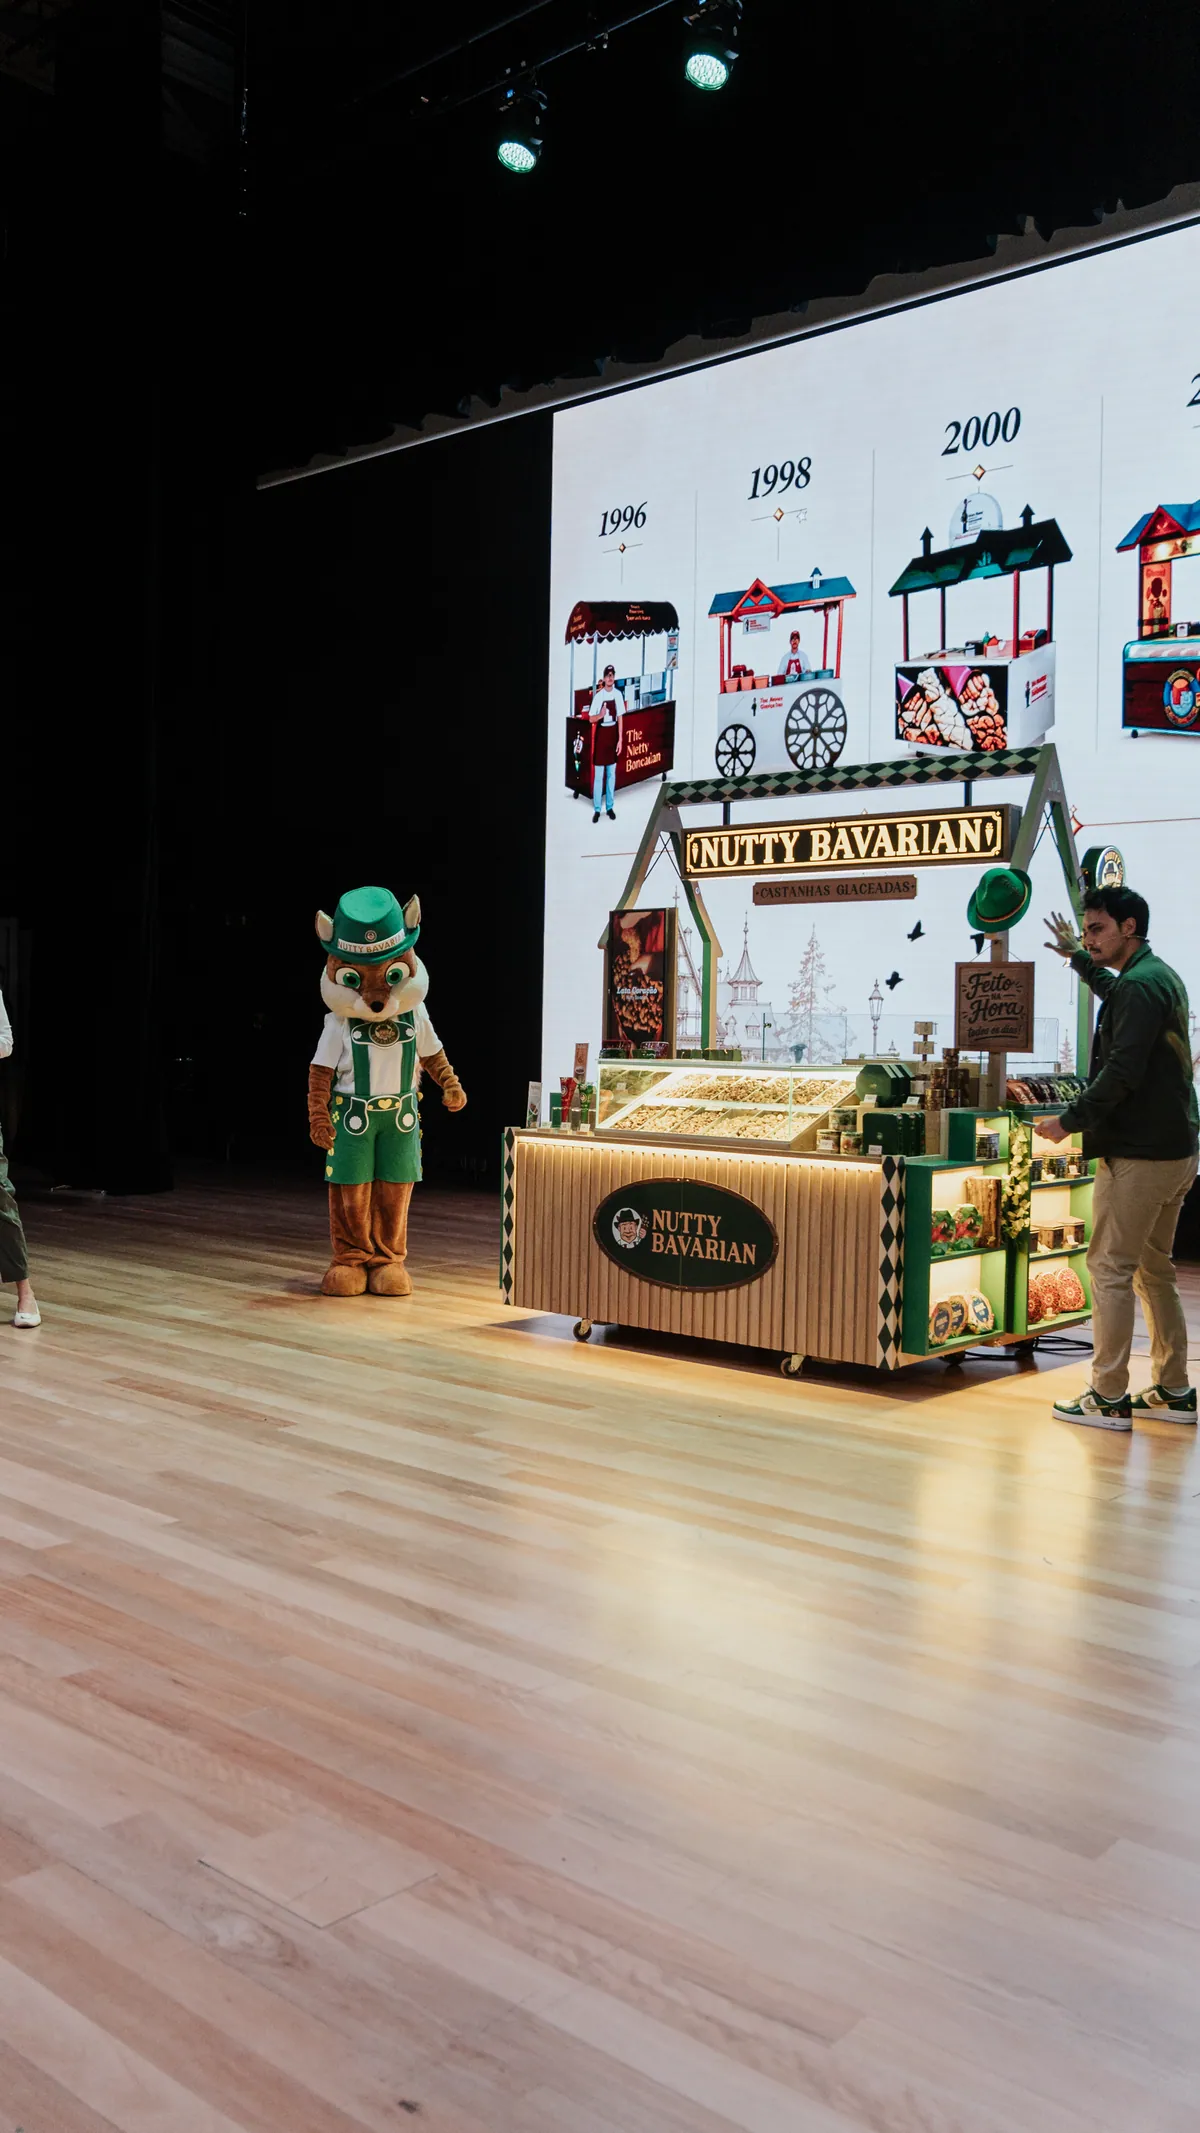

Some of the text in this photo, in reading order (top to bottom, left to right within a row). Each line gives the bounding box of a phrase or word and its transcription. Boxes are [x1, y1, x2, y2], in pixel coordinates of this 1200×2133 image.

[941, 407, 1021, 456] 2000
[747, 456, 812, 500] 1998
[598, 501, 648, 537] 1996
[626, 729, 643, 743] The
[700, 818, 983, 868] NUTTY BAVARIAN
[760, 885, 830, 898] CASTANHAS
[338, 941, 364, 953] NUTTY
[965, 971, 1014, 1001] Feito
[968, 1000, 1024, 1024] Hora
[652, 1209, 722, 1237] NUTTY
[652, 1232, 756, 1265] BAVARIAN
